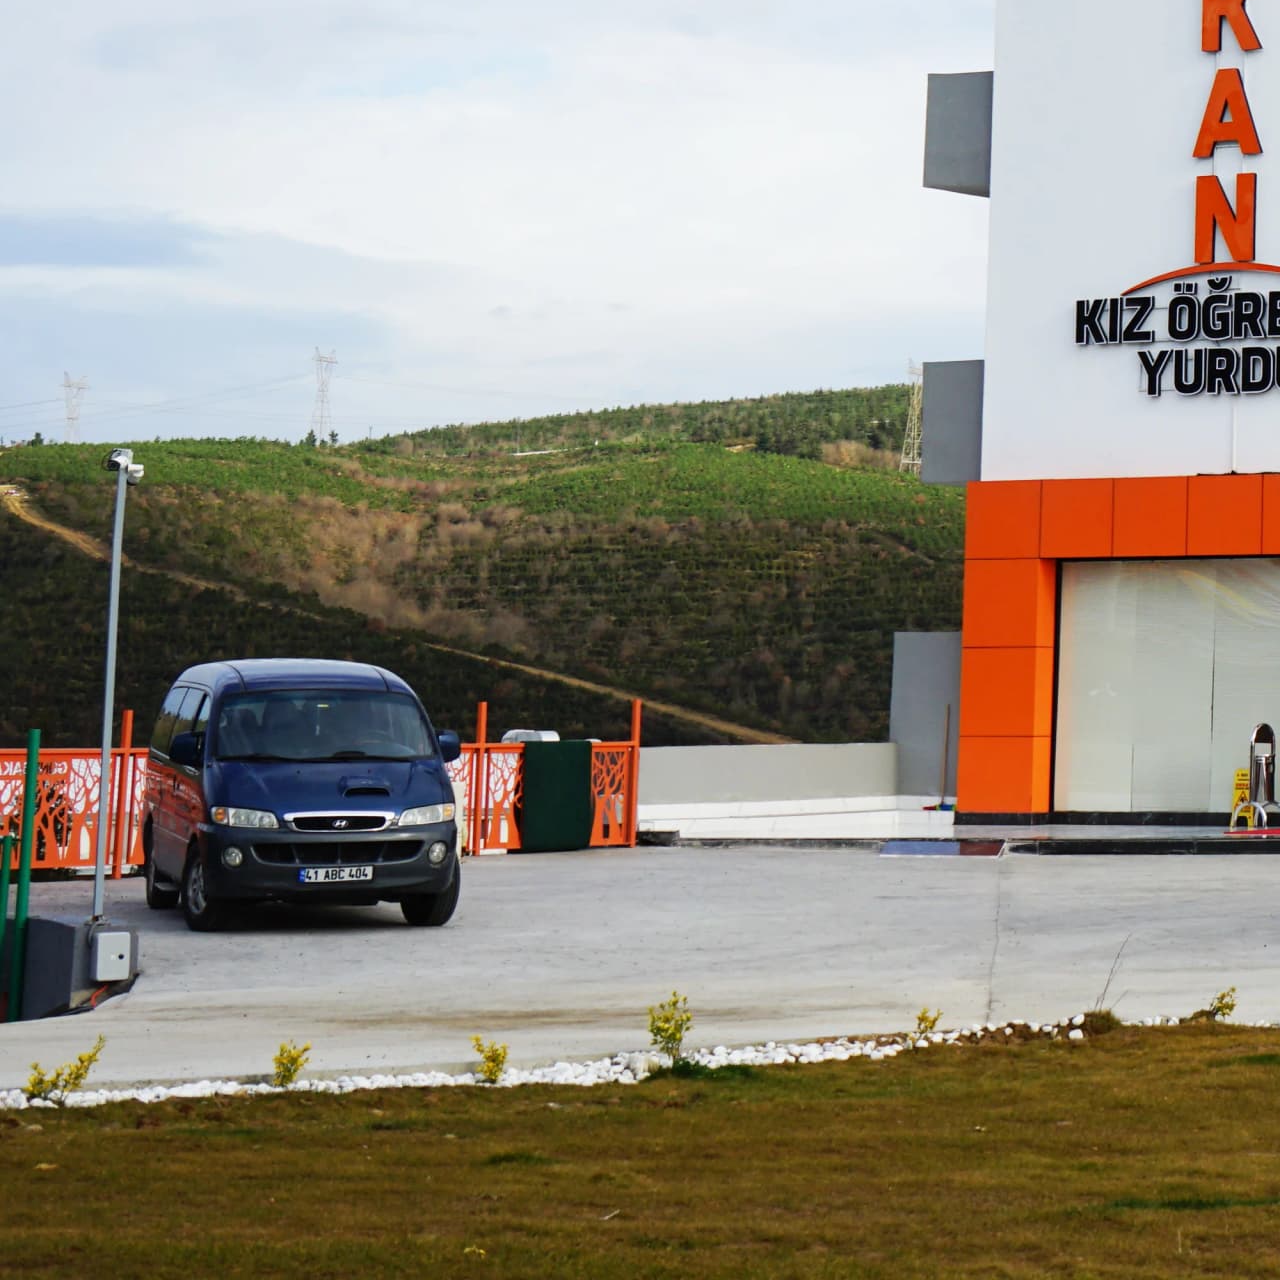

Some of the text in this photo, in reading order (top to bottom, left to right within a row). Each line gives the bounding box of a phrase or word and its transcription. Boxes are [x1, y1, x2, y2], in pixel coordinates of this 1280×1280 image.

[1074, 295, 1155, 345] KIZ
[305, 867, 369, 881] 41 ABC 404
